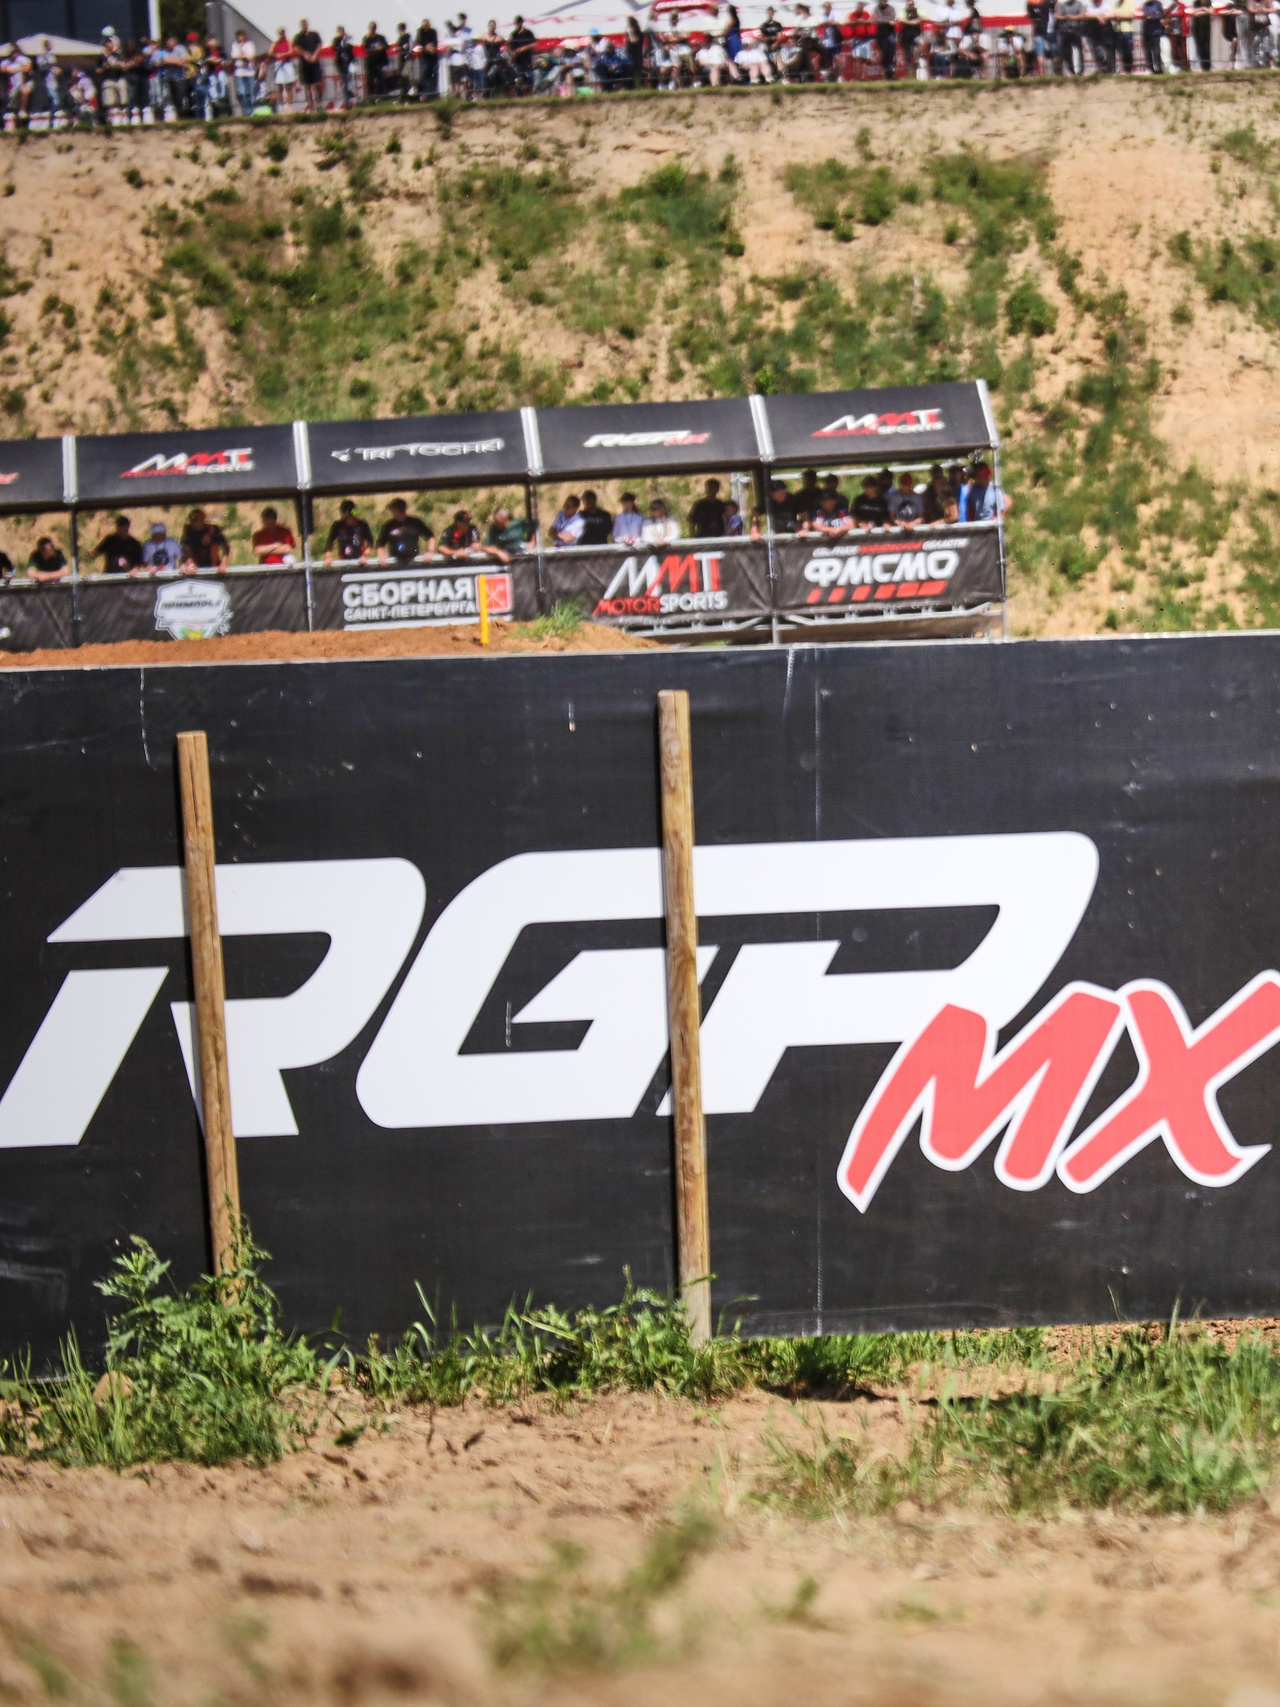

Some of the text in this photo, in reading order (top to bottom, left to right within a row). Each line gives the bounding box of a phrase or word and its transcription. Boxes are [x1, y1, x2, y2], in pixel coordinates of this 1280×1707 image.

[603, 551, 725, 600] MMT
[804, 550, 960, 588] ФМСМО
[343, 577, 475, 608] СБОРНАЯ
[592, 590, 728, 616] MOTORSPORTS
[343, 601, 478, 622] САНКТ-ПЕТЕРБУРГА
[0, 831, 1100, 1148] RGP
